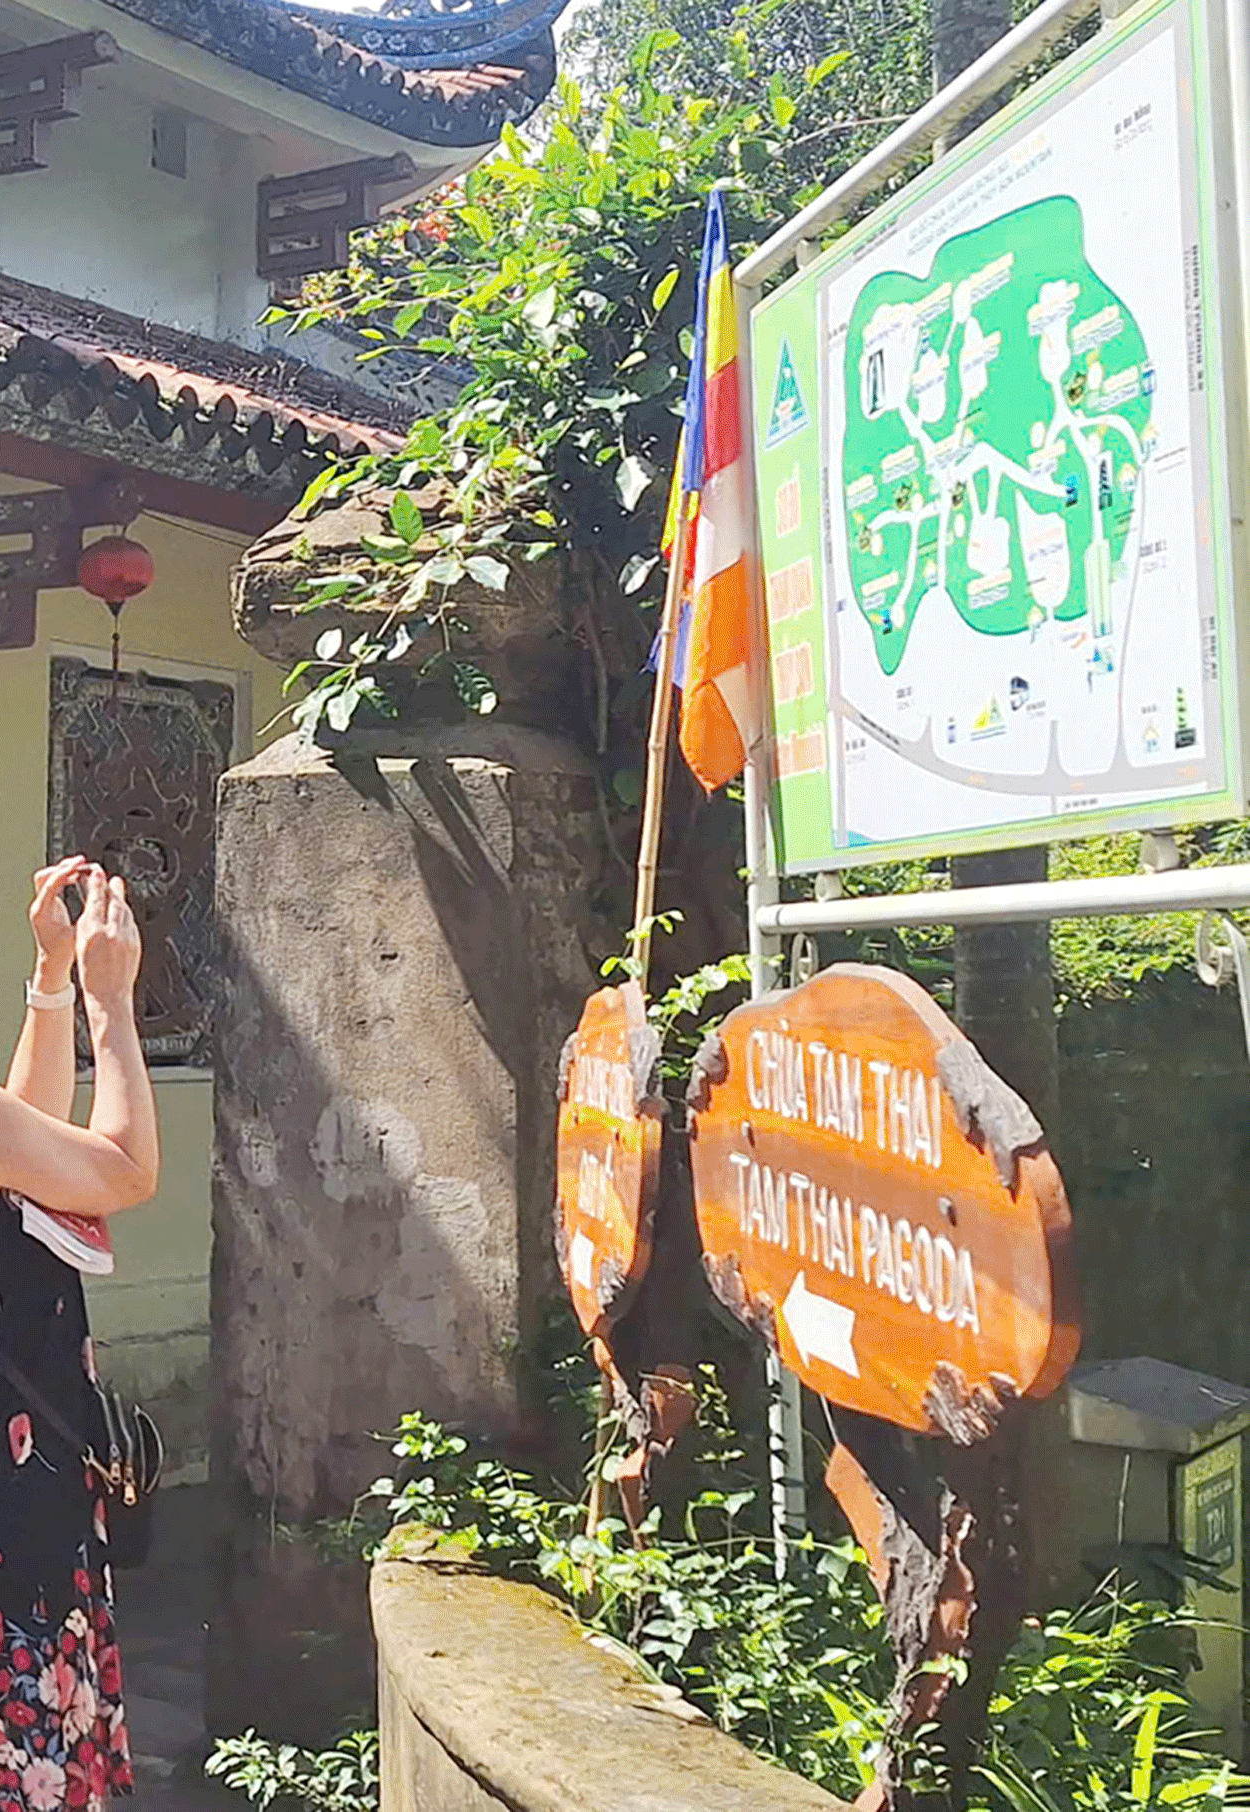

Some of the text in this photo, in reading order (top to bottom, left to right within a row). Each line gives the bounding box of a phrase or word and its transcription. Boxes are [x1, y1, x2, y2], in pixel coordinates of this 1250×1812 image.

[808, 1041, 863, 1143] TAM
[729, 1151, 789, 1250] TAM
[789, 1171, 855, 1278] THAI
[859, 1204, 981, 1335] PAGODA
